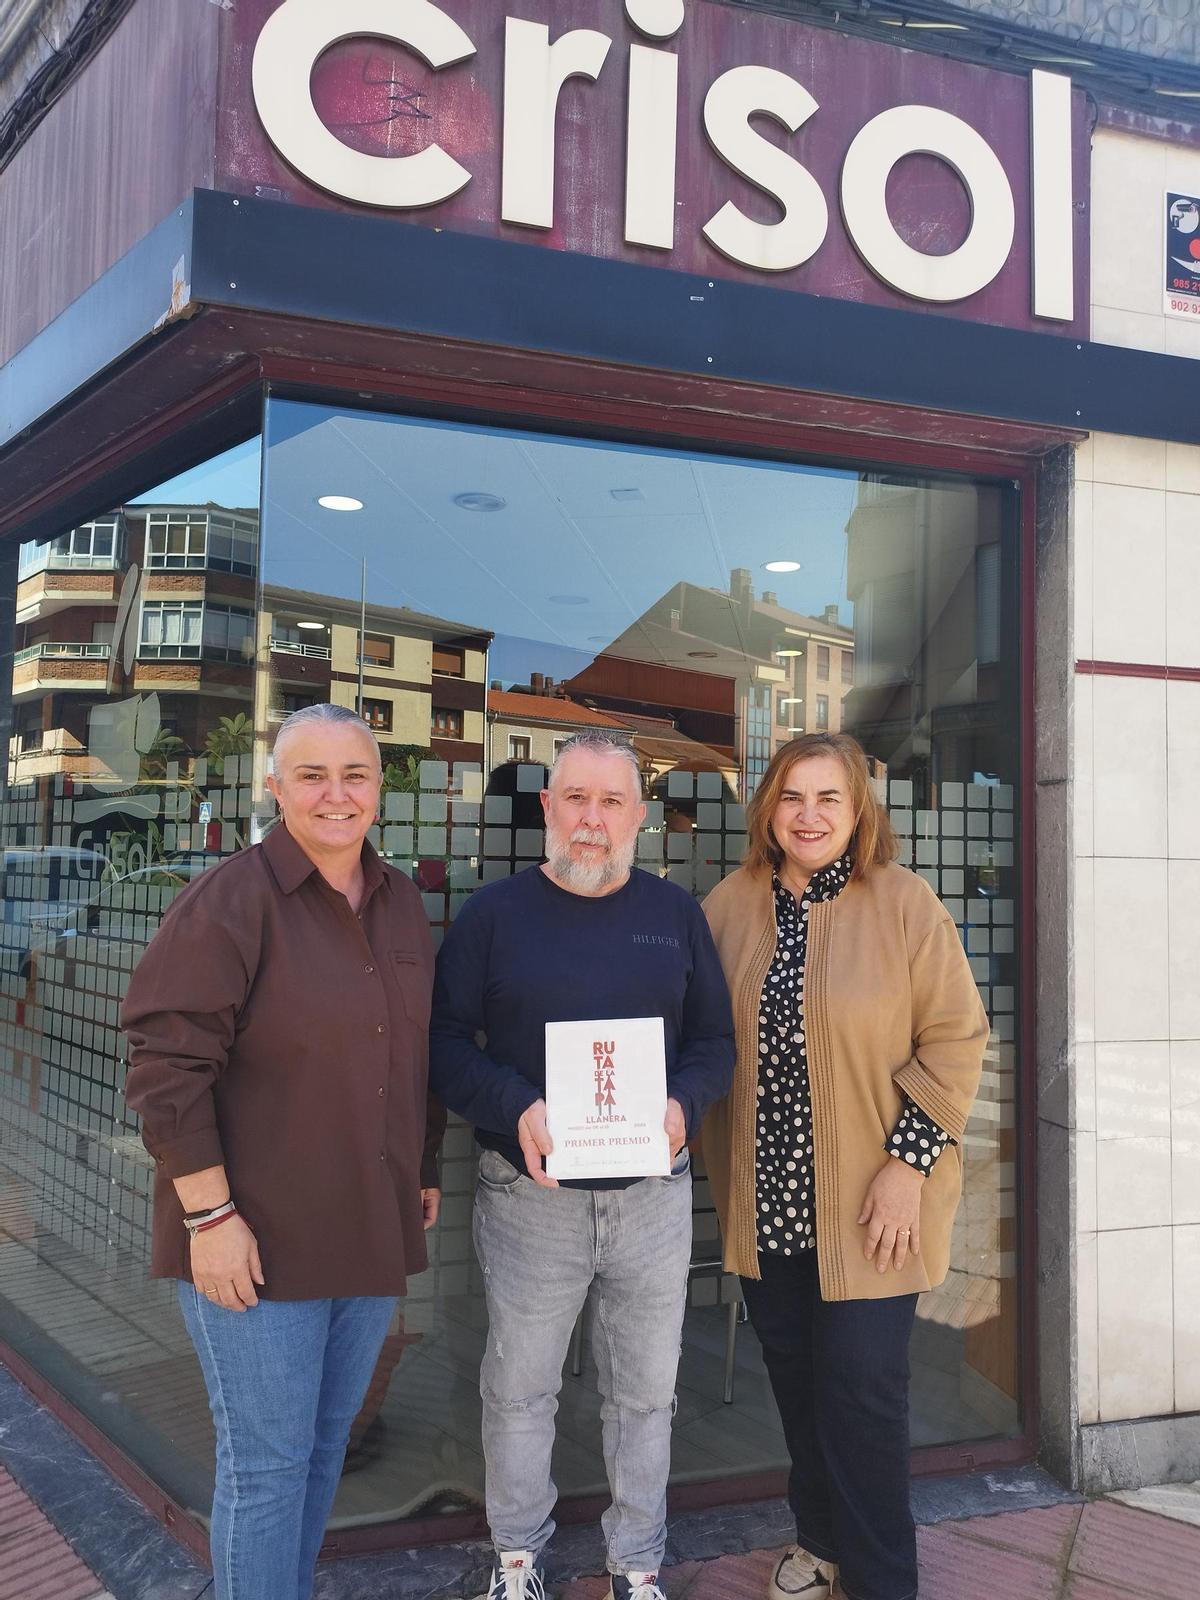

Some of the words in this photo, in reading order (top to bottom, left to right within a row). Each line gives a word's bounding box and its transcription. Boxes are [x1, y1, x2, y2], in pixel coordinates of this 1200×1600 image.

[1173, 278, 1190, 289] 985
[1171, 299, 1189, 313] 902
[633, 934, 680, 949] HILFIGER
[586, 1114, 627, 1124] LLANERA
[564, 1137, 606, 1148] PRIMER
[608, 1135, 651, 1147] PREMIO
